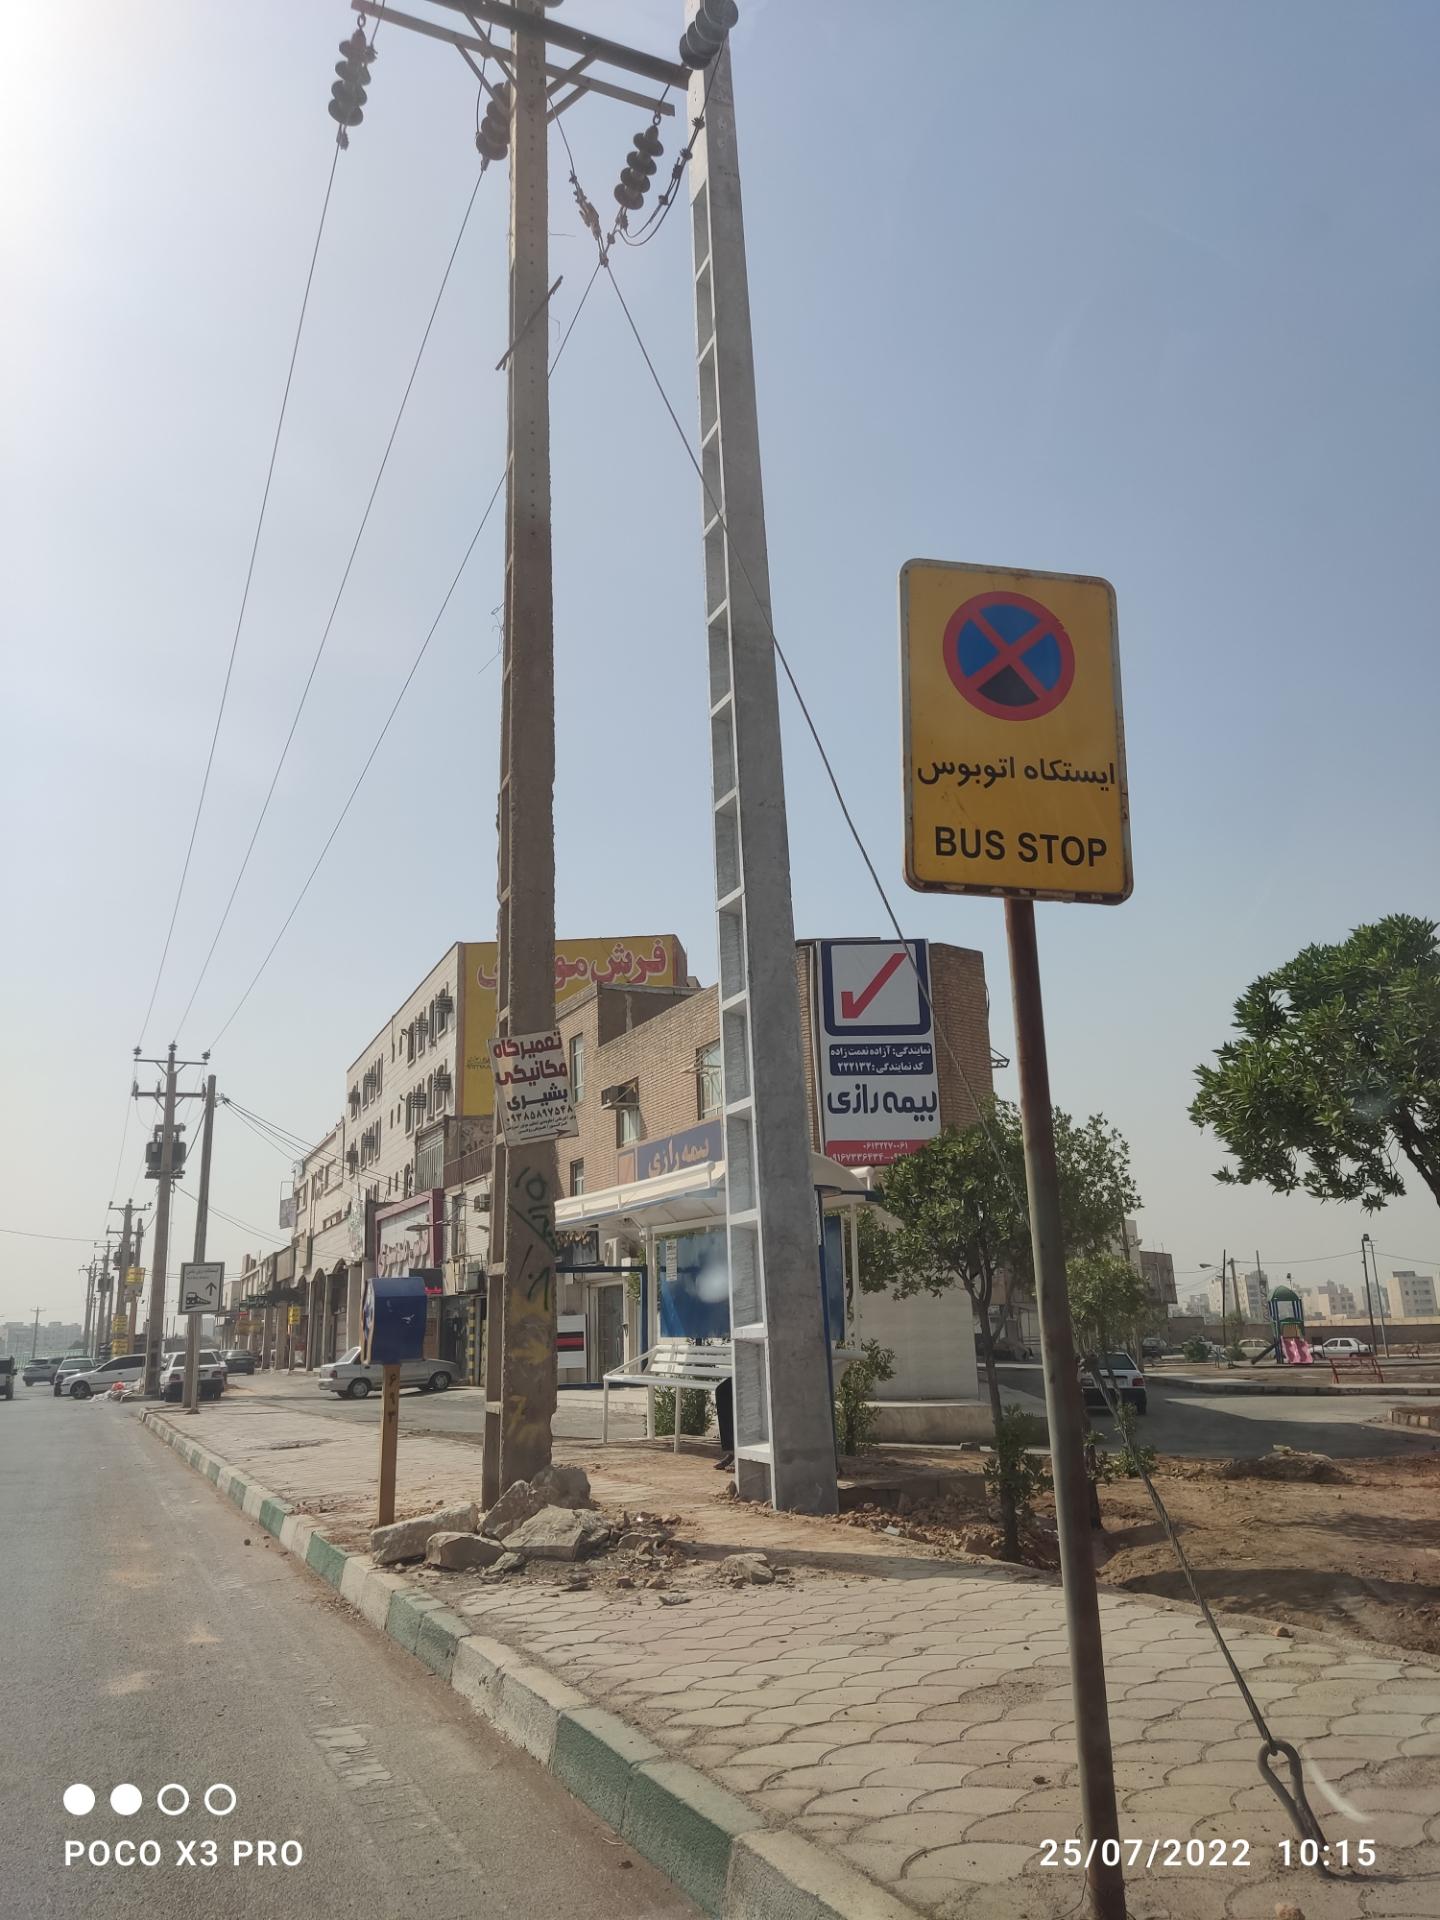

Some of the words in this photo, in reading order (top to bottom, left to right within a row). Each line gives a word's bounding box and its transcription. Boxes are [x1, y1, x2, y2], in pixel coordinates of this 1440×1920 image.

[917, 756, 1015, 788] اتوبوس
[935, 826, 1005, 860] BUS
[1017, 832, 1107, 867] STOP
[589, 938, 667, 985] فرش
[495, 1060, 568, 1086] مکانیکی
[506, 1083, 568, 1111] بشیری
[827, 1083, 879, 1114] رازی
[883, 1090, 938, 1122] بیمه
